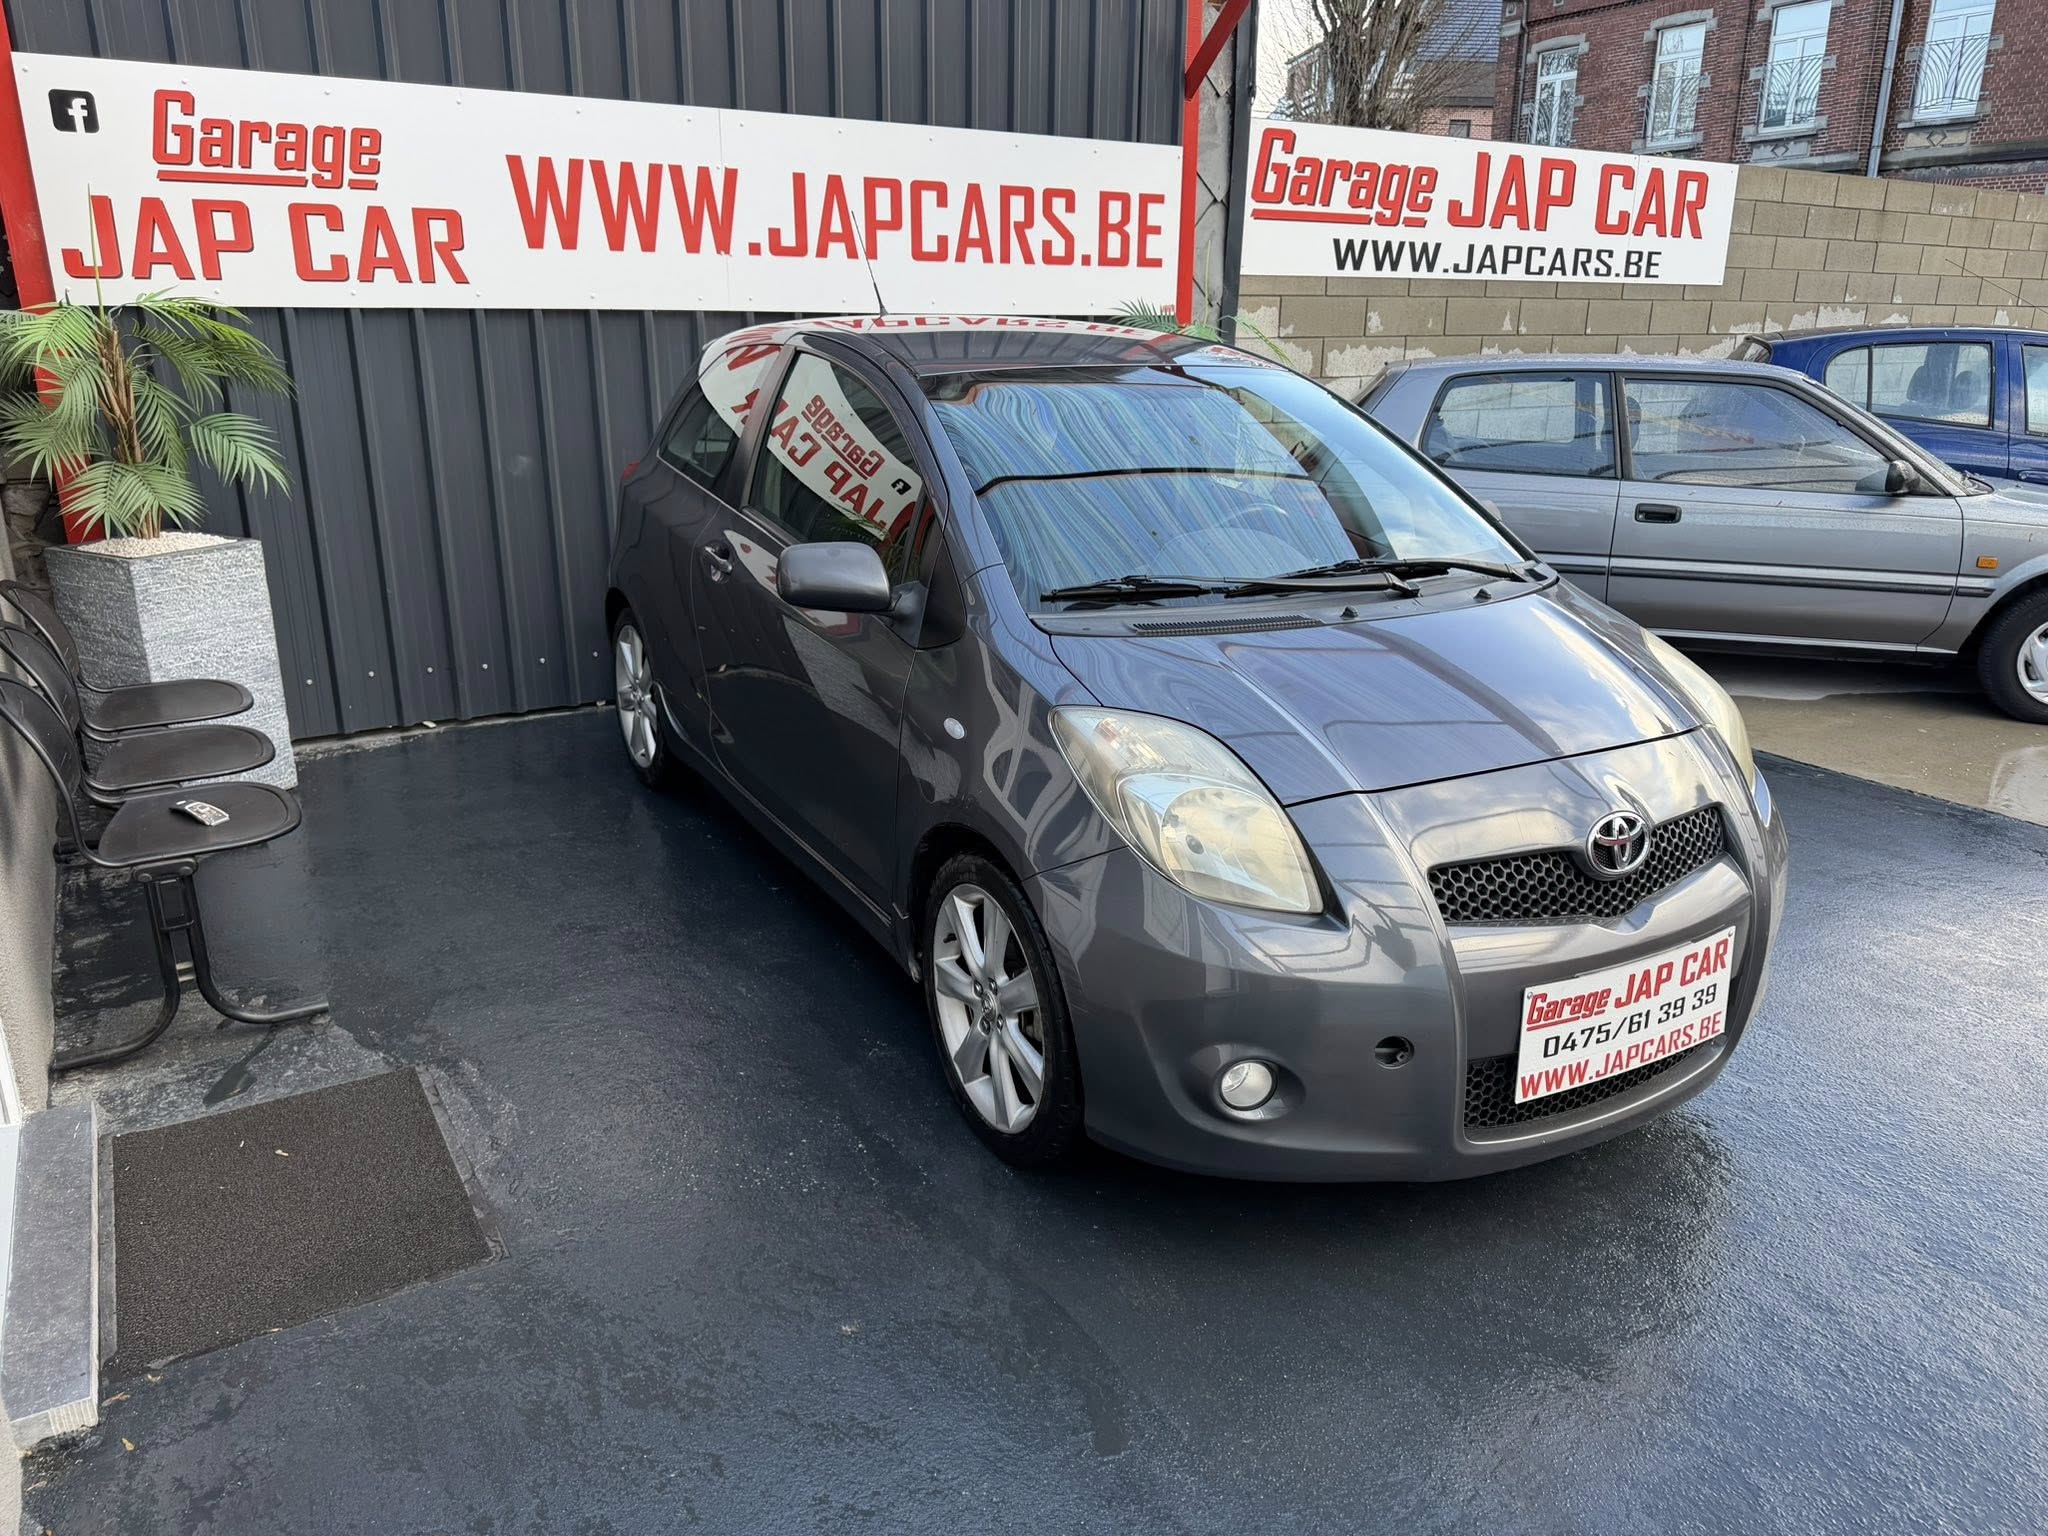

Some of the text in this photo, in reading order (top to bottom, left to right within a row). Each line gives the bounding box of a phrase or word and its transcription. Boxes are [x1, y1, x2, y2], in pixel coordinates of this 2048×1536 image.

[153, 90, 381, 190] Garage
[1252, 128, 1709, 239] Garage JAP CAR
[61, 194, 470, 284] JAP CAR
[502, 154, 1166, 269] WWW.JAPCARS.BE
[1333, 238, 1662, 279] WWW.JAPCARS.BE
[1526, 937, 1729, 1027] Garage JAP CAR
[1543, 983, 1717, 1058] 0475/61 39 39
[1520, 1010, 1722, 1099] WWW.JAPCARS.BE
